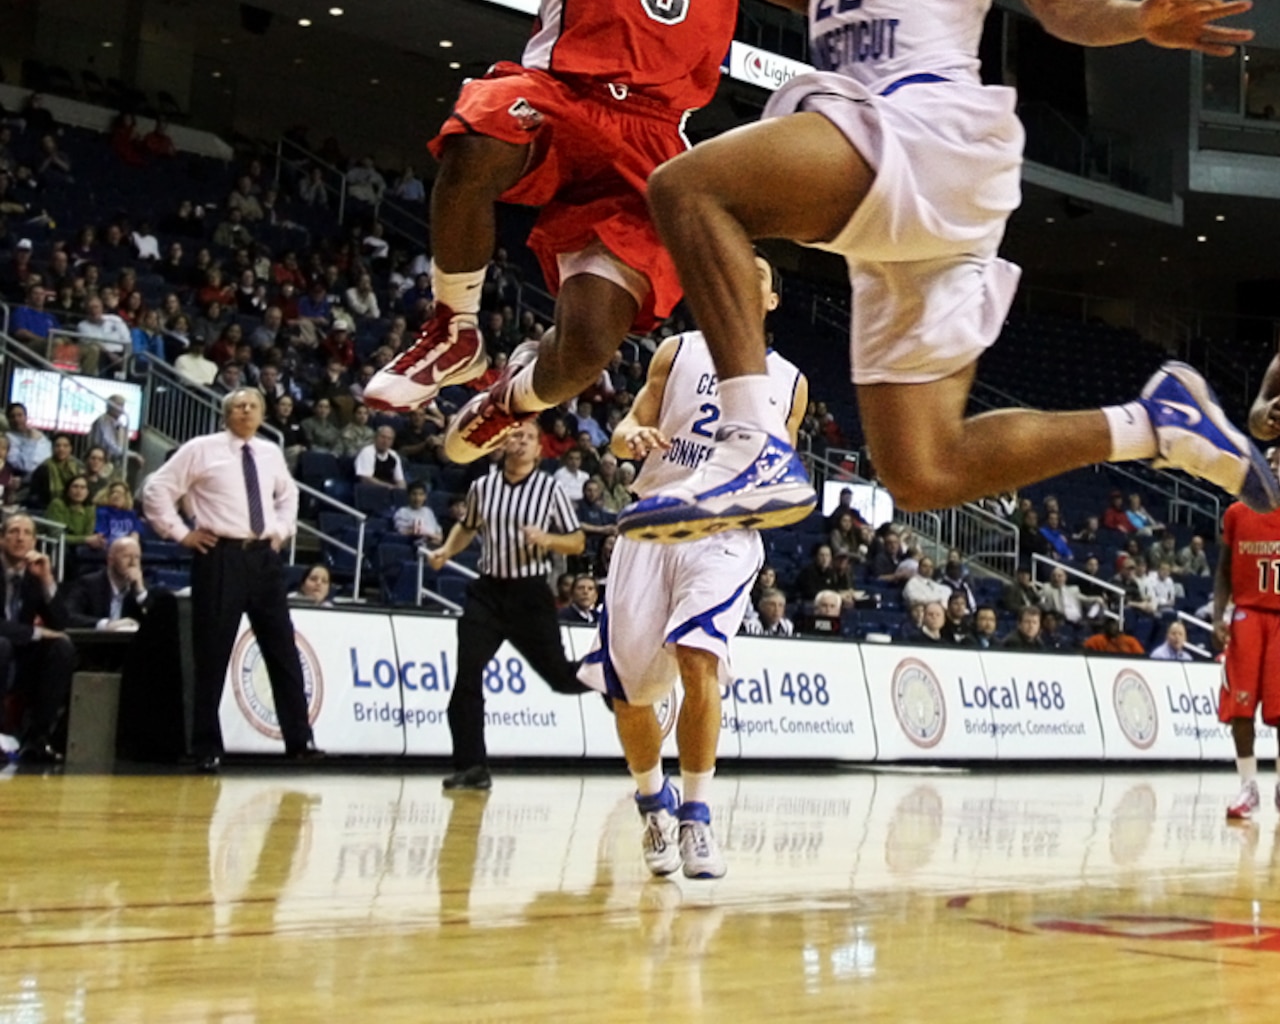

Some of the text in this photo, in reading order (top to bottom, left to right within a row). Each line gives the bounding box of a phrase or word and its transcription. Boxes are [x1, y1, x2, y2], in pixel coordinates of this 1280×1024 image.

[696, 373, 719, 397] CE
[350, 647, 450, 692] Local
[484, 657, 527, 695] 88
[780, 672, 830, 706] 488
[958, 676, 1020, 709] Local
[1025, 680, 1065, 711] 488
[1166, 684, 1219, 716] Local
[353, 701, 558, 729] Bridgepor nnecticut
[779, 716, 855, 735] Connecticut
[1026, 719, 1086, 736] Connecticut
